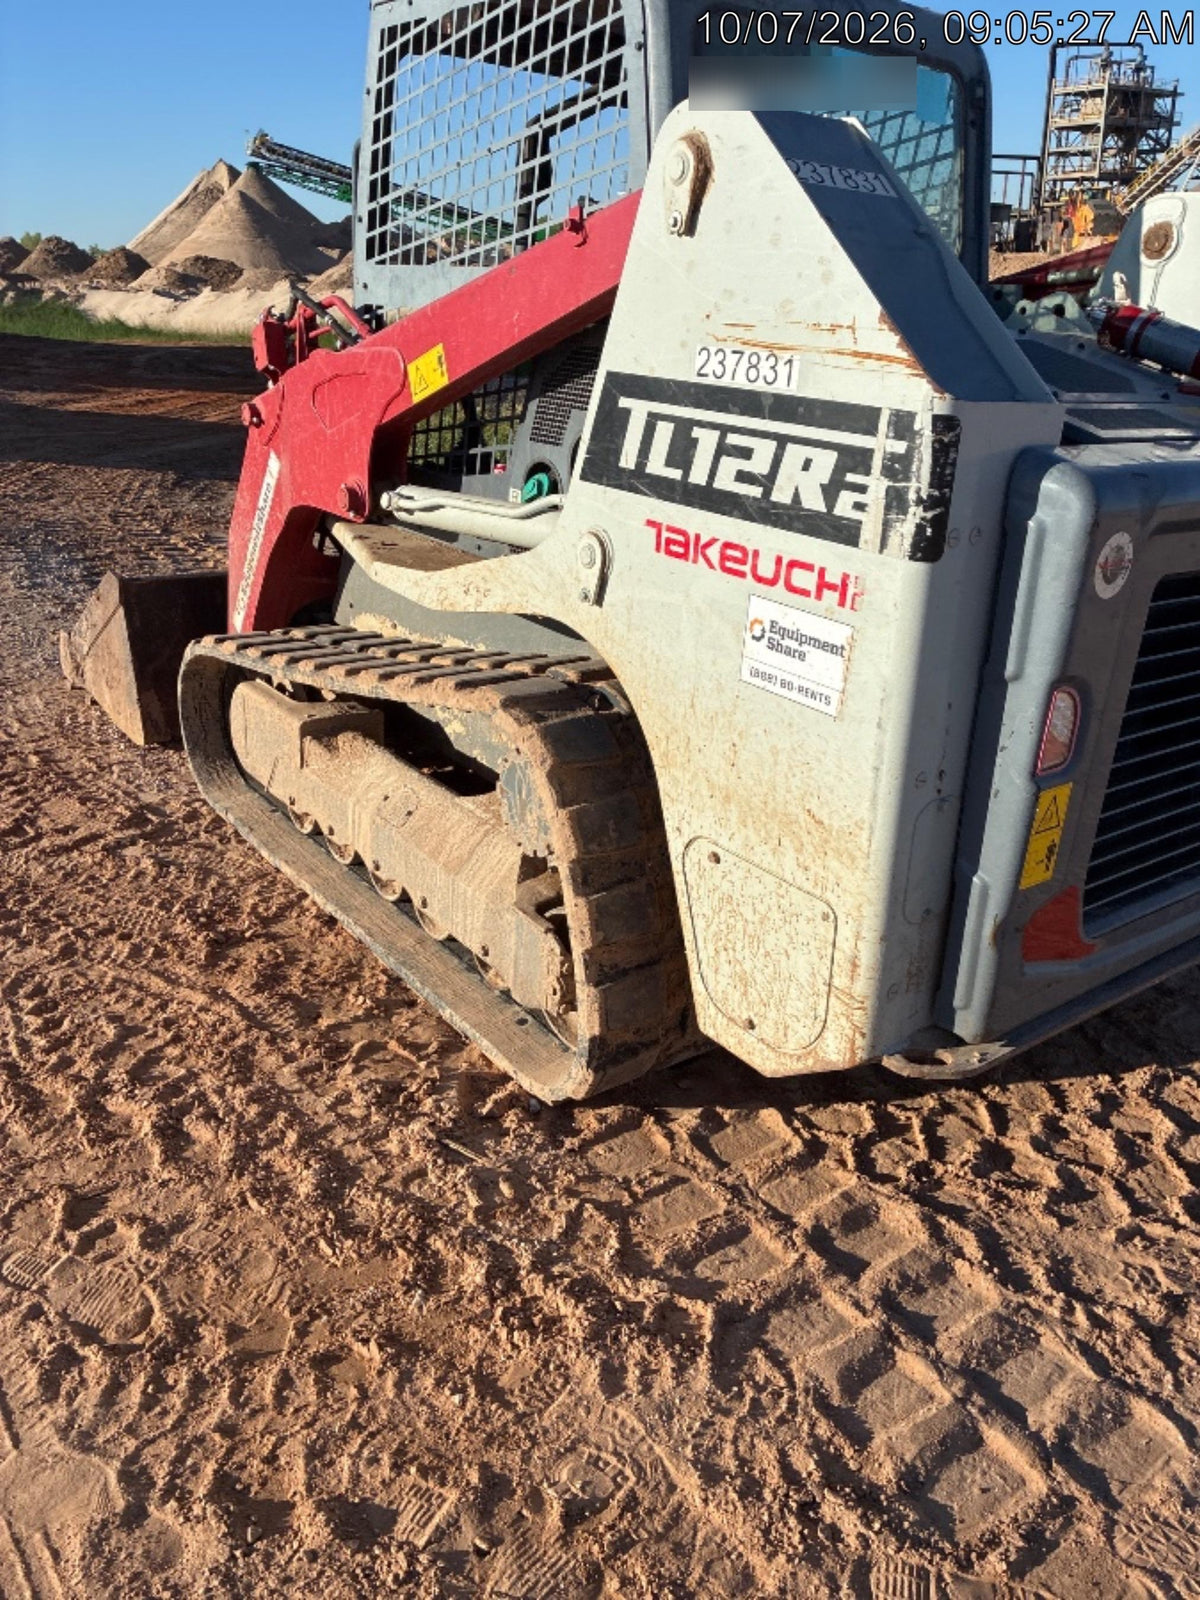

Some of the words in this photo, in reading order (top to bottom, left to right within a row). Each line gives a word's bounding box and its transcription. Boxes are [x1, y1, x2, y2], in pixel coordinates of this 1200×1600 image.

[785, 157, 891, 195] 237831
[696, 346, 796, 387] 237831
[766, 636, 807, 662] Share
[768, 619, 848, 658] Equipment
